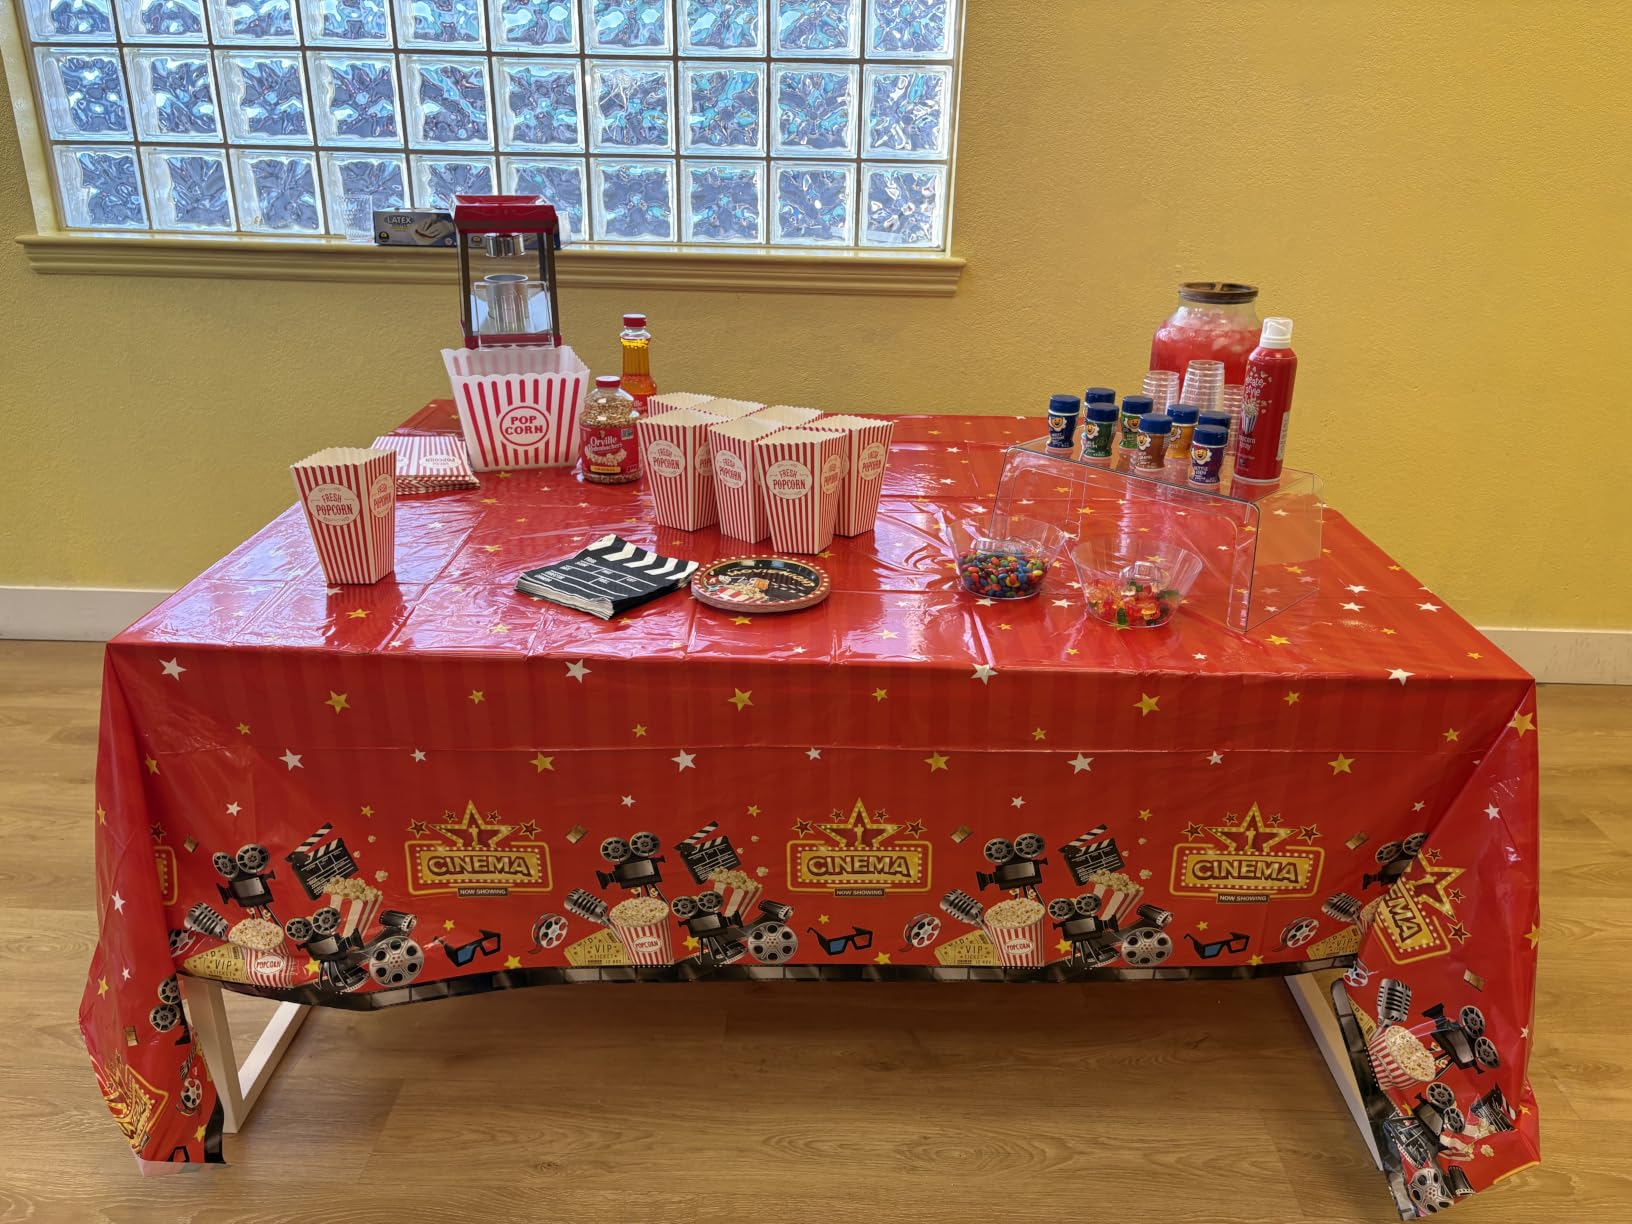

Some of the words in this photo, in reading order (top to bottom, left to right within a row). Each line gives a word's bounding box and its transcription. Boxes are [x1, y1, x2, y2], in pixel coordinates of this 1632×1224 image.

[387, 216, 412, 224] LATEX
[510, 415, 537, 425] POP
[505, 425, 543, 435] CORN
[590, 436, 617, 447] Orville
[652, 456, 680, 470] POPCORN
[719, 466, 742, 481] POPCORN
[779, 468, 797, 479] FRESH
[773, 479, 806, 490] POPCORN
[321, 493, 342, 504] FRESH
[315, 503, 353, 516] POPCORN
[427, 855, 533, 877] CINEMA
[806, 855, 912, 878] CINEMA
[1192, 859, 1299, 884] CINEMA
[594, 944, 612, 953] VIP
[635, 941, 659, 949] POPCORN
[965, 945, 983, 954] VIP
[214, 959, 232, 970] VIP
[256, 960, 281, 969] POPCORN
